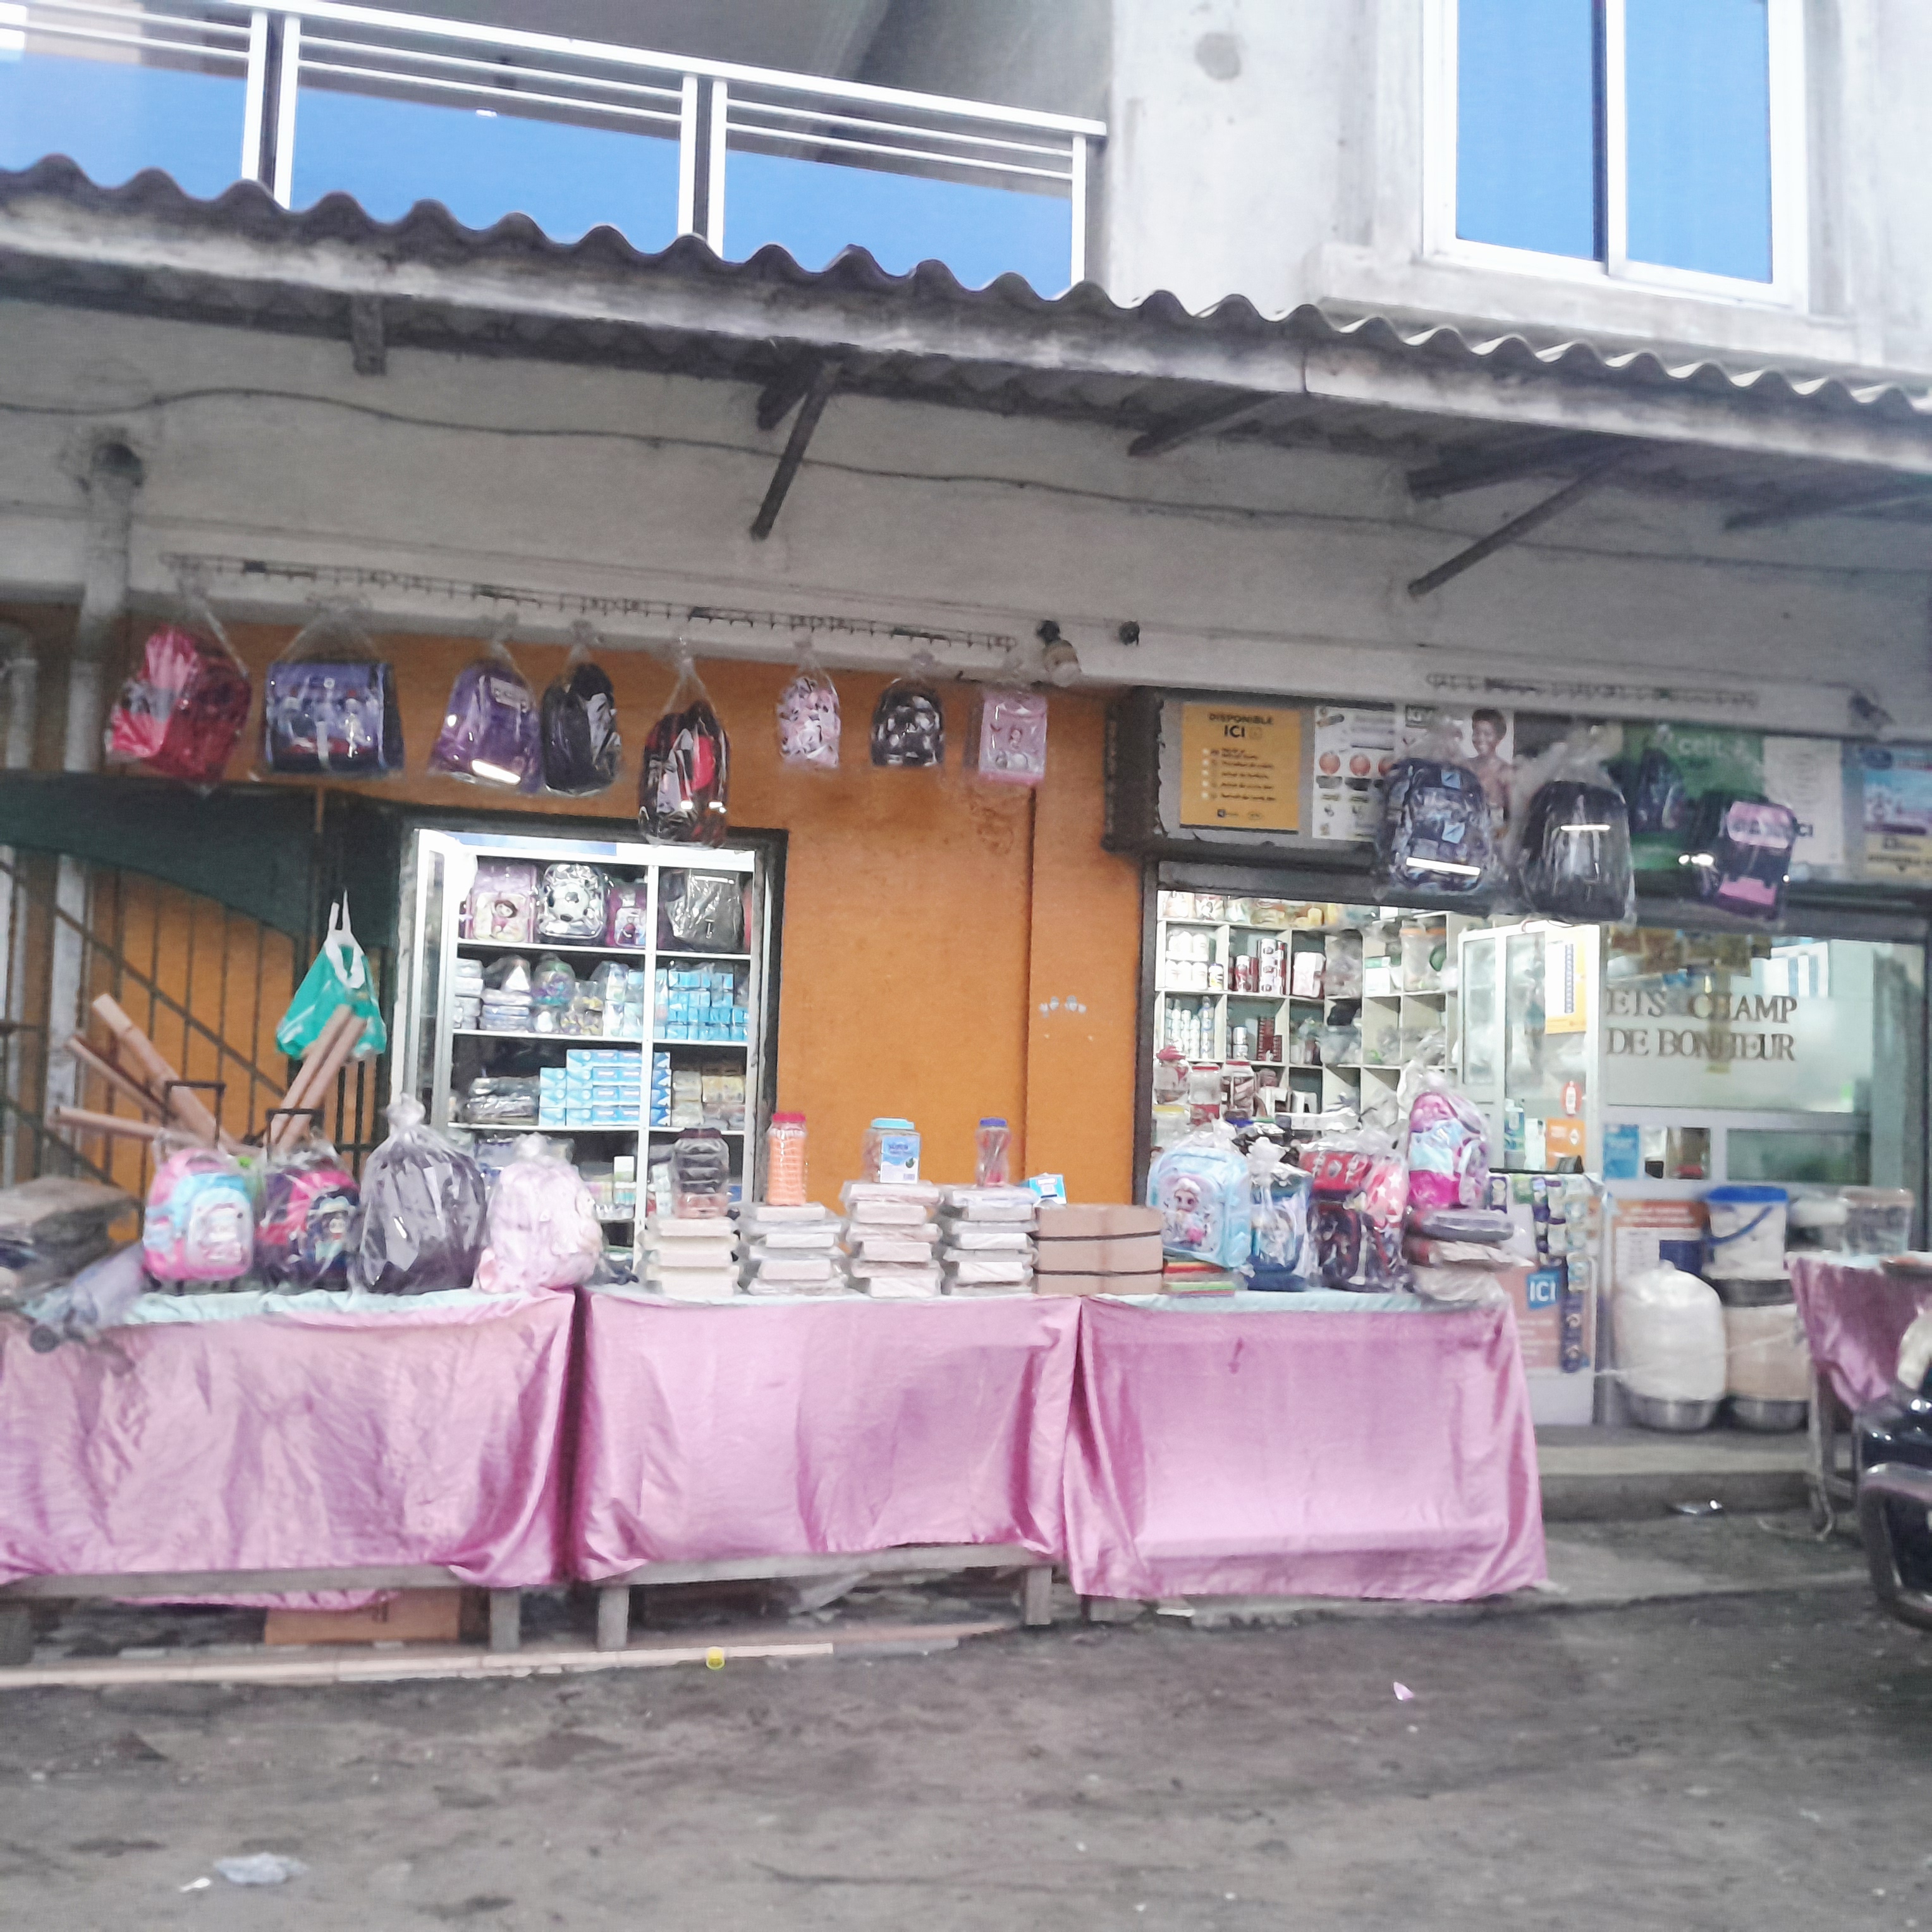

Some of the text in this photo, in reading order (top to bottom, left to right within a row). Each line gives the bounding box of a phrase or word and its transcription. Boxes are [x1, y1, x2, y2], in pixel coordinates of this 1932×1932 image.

[1223, 724, 1246, 738] ICI
[1686, 991, 1798, 1024] CHAMP
[1606, 1027, 1649, 1057] DE
[1529, 1280, 1556, 1302] ICI
